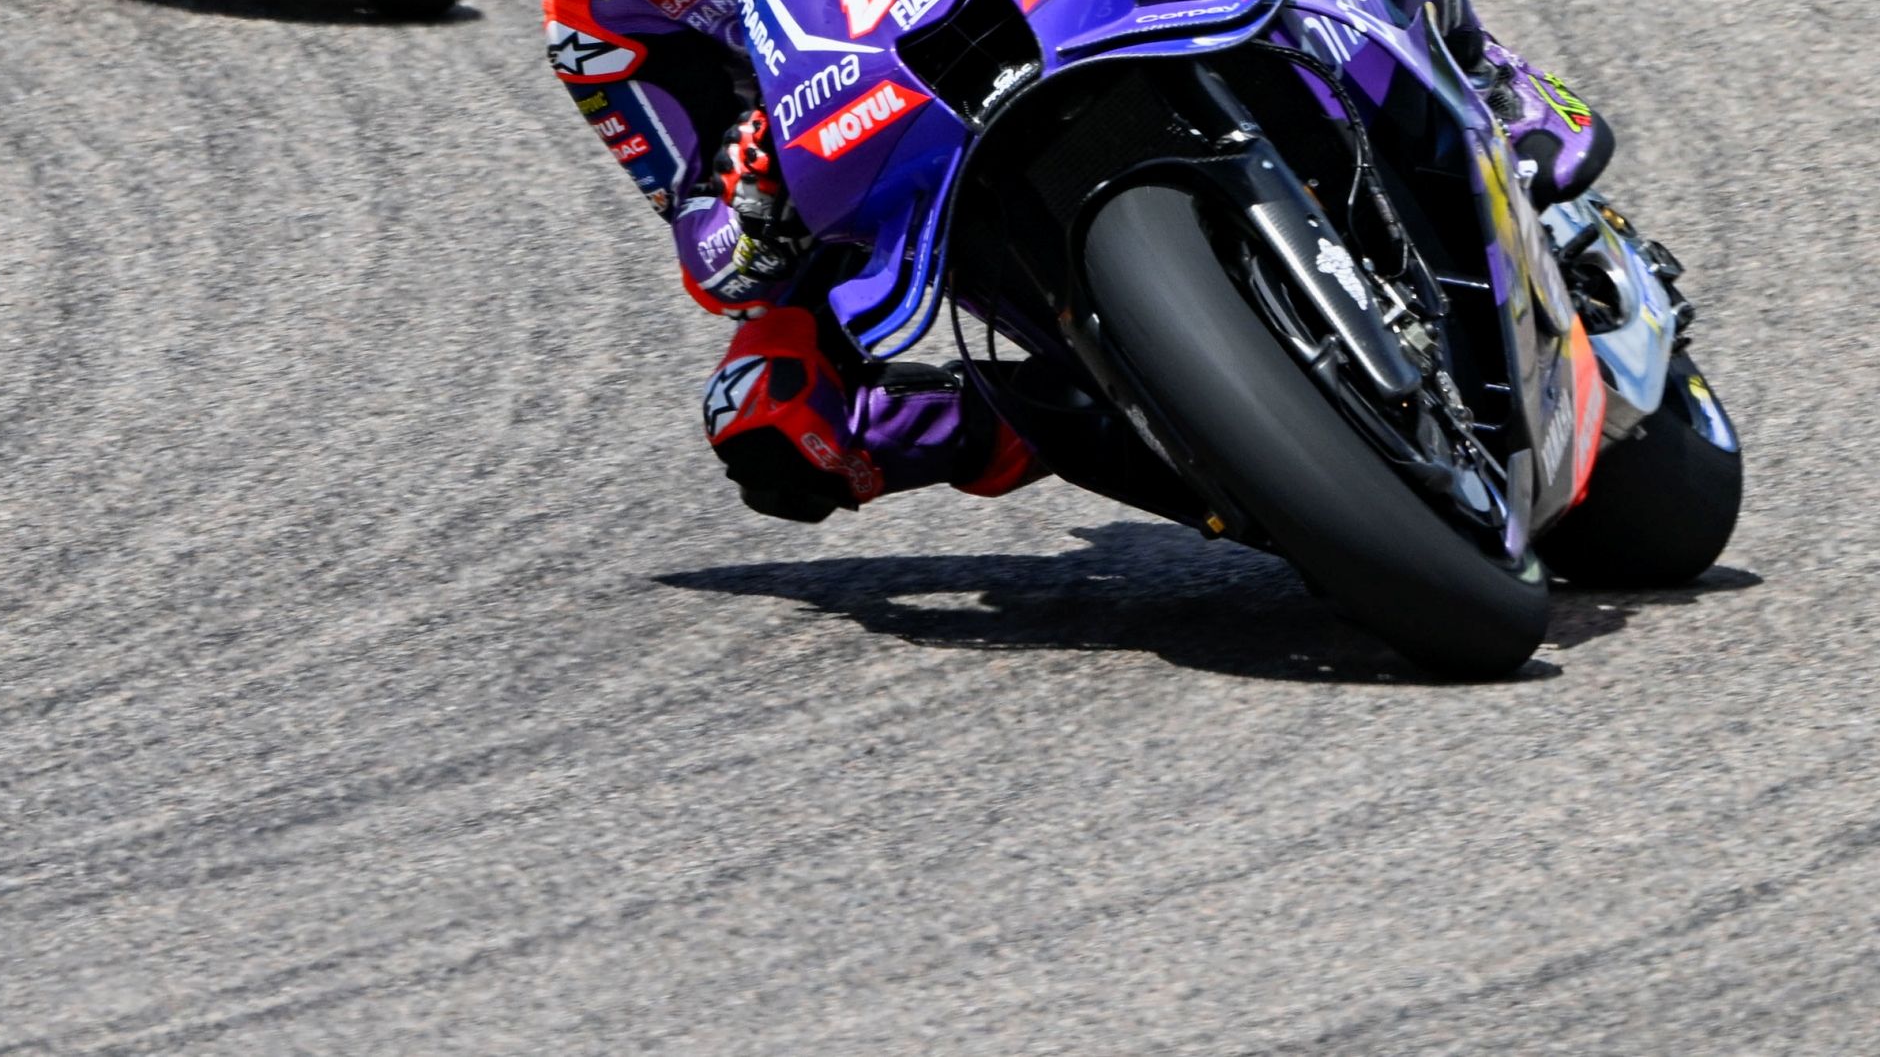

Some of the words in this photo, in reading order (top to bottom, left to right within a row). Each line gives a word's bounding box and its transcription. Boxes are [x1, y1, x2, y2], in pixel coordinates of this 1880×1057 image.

[1135, 1, 1241, 23] Corpay
[774, 54, 860, 141] prima
[819, 84, 905, 157] MOTUL
[720, 254, 779, 299] PRAAC
